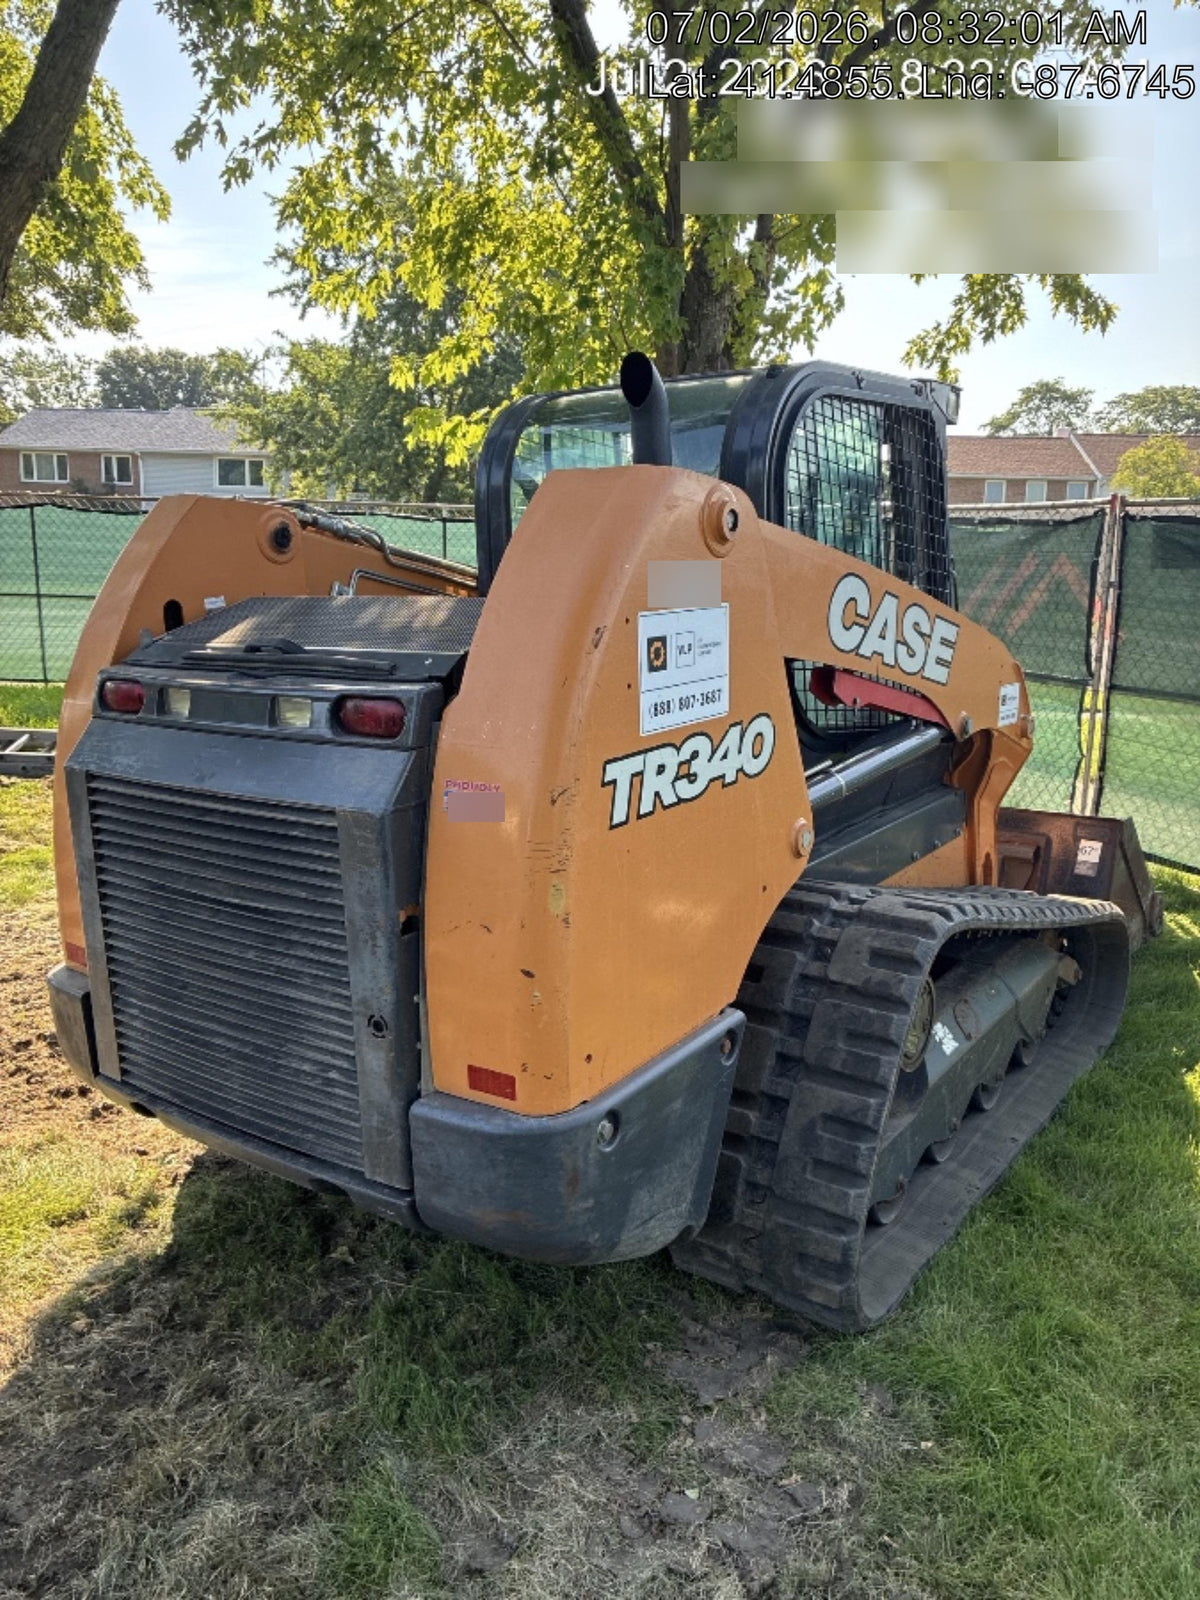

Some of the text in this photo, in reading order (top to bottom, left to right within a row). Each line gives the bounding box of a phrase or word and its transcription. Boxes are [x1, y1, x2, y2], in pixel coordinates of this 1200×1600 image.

[827, 572, 960, 686] CASE
[648, 698, 676, 719] (888)
[600, 712, 776, 830] TR340
